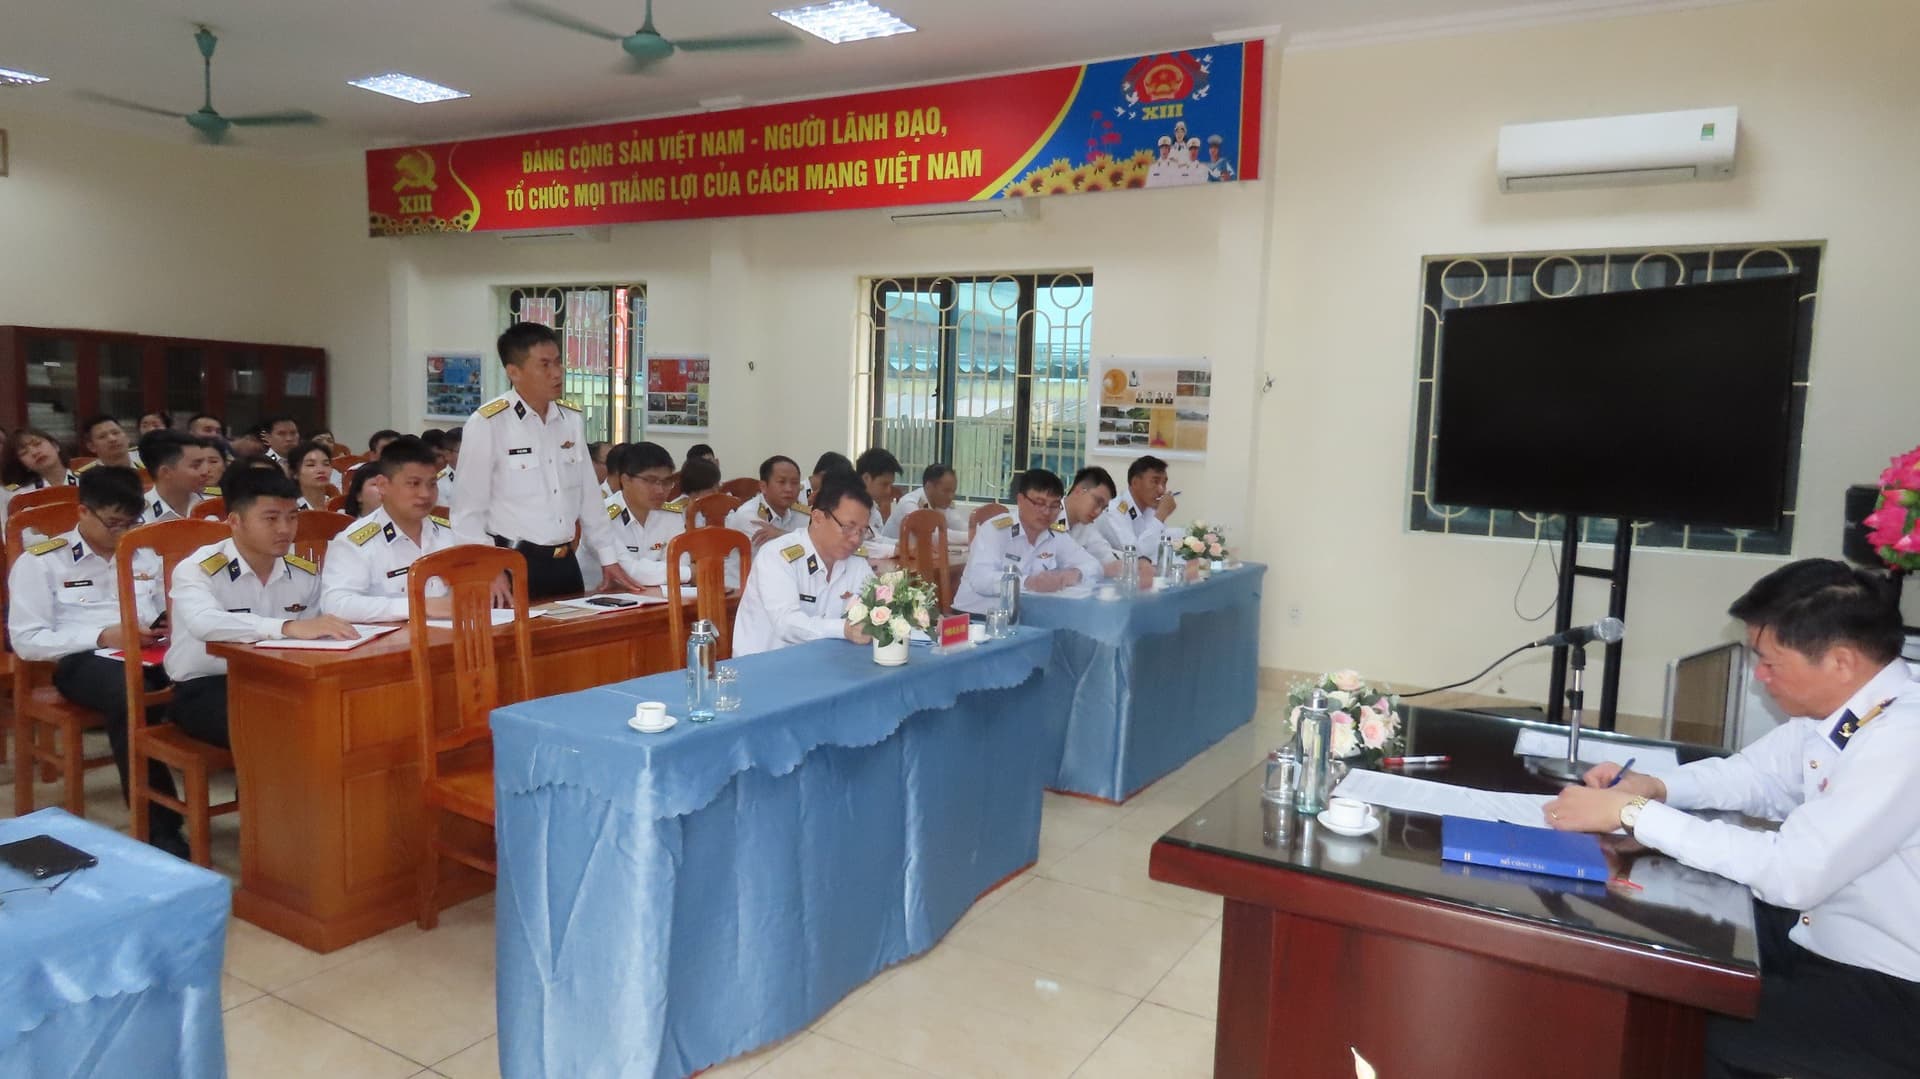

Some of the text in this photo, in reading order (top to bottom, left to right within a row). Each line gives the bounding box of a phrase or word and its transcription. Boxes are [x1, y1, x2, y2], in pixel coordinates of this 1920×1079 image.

[1142, 103, 1184, 120] XIII
[522, 140, 565, 174] ĐẢNG
[569, 140, 614, 174] CỘNG
[618, 129, 654, 165] SẢN
[659, 130, 696, 165] VIỆT
[701, 128, 745, 157] NAM
[764, 113, 826, 151] NGƯỜI
[832, 111, 888, 145] LÃNH
[895, 106, 948, 143] ĐẠO,
[506, 149, 982, 212] TỔ CHỨC MỌI THẮNG LỢI CỦA CÁCH MẠNG VIỆT NAM
[399, 195, 432, 213] XIII
